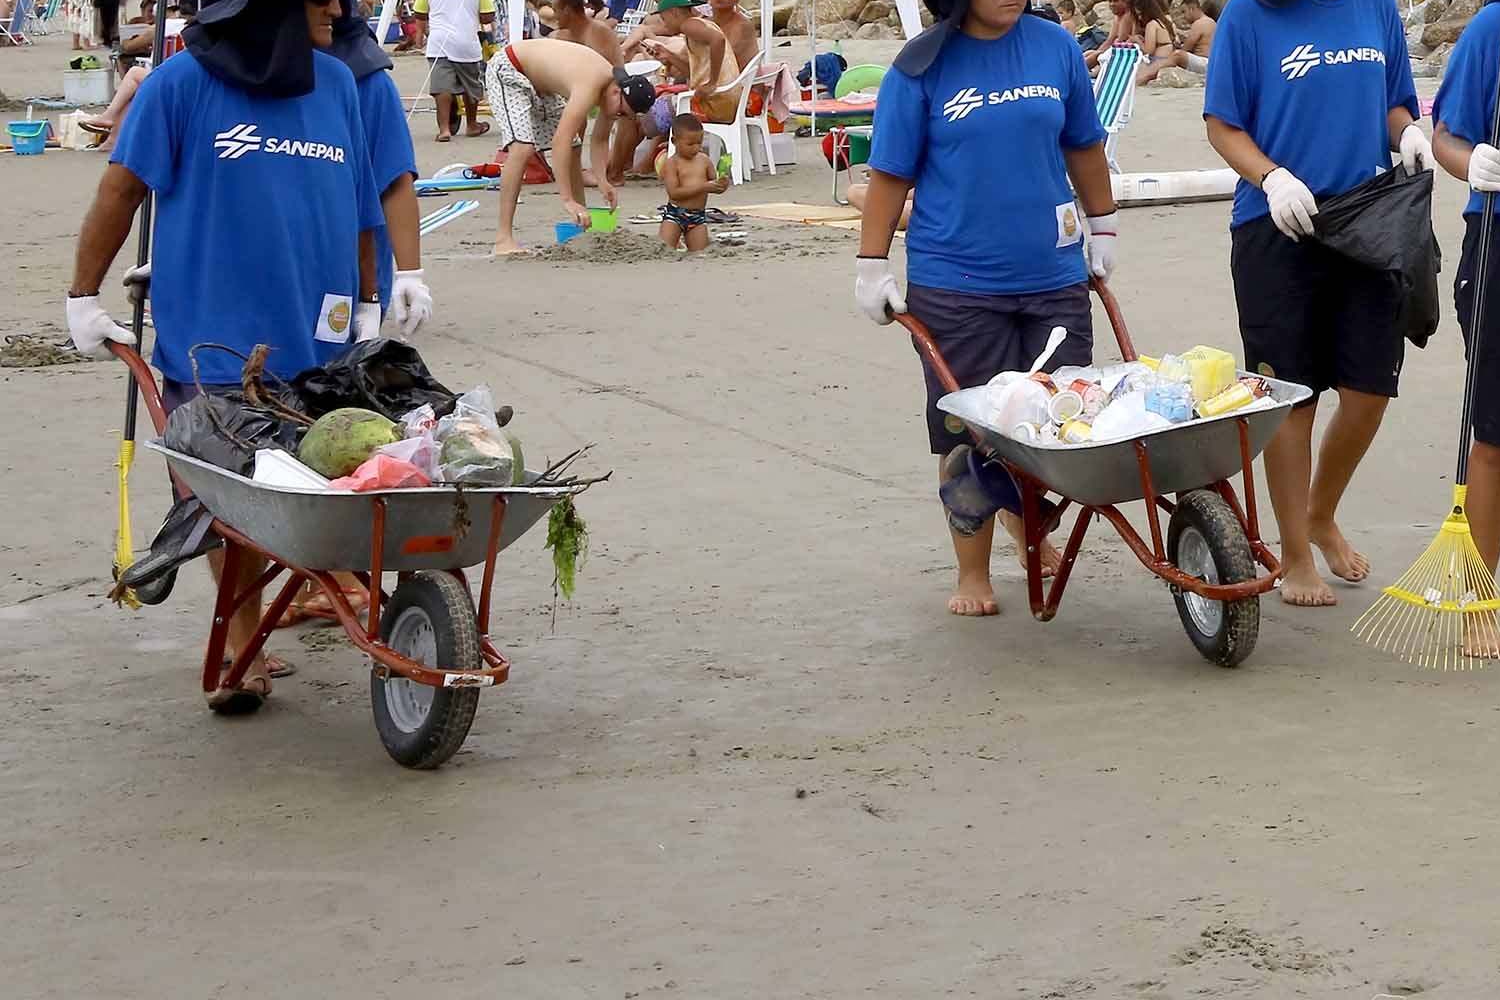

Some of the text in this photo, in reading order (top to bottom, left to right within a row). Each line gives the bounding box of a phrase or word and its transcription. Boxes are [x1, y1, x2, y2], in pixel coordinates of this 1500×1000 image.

[1324, 47, 1386, 66] SANEPA
[988, 85, 1061, 105] SANEPAR
[263, 138, 345, 163] SANEPAR
